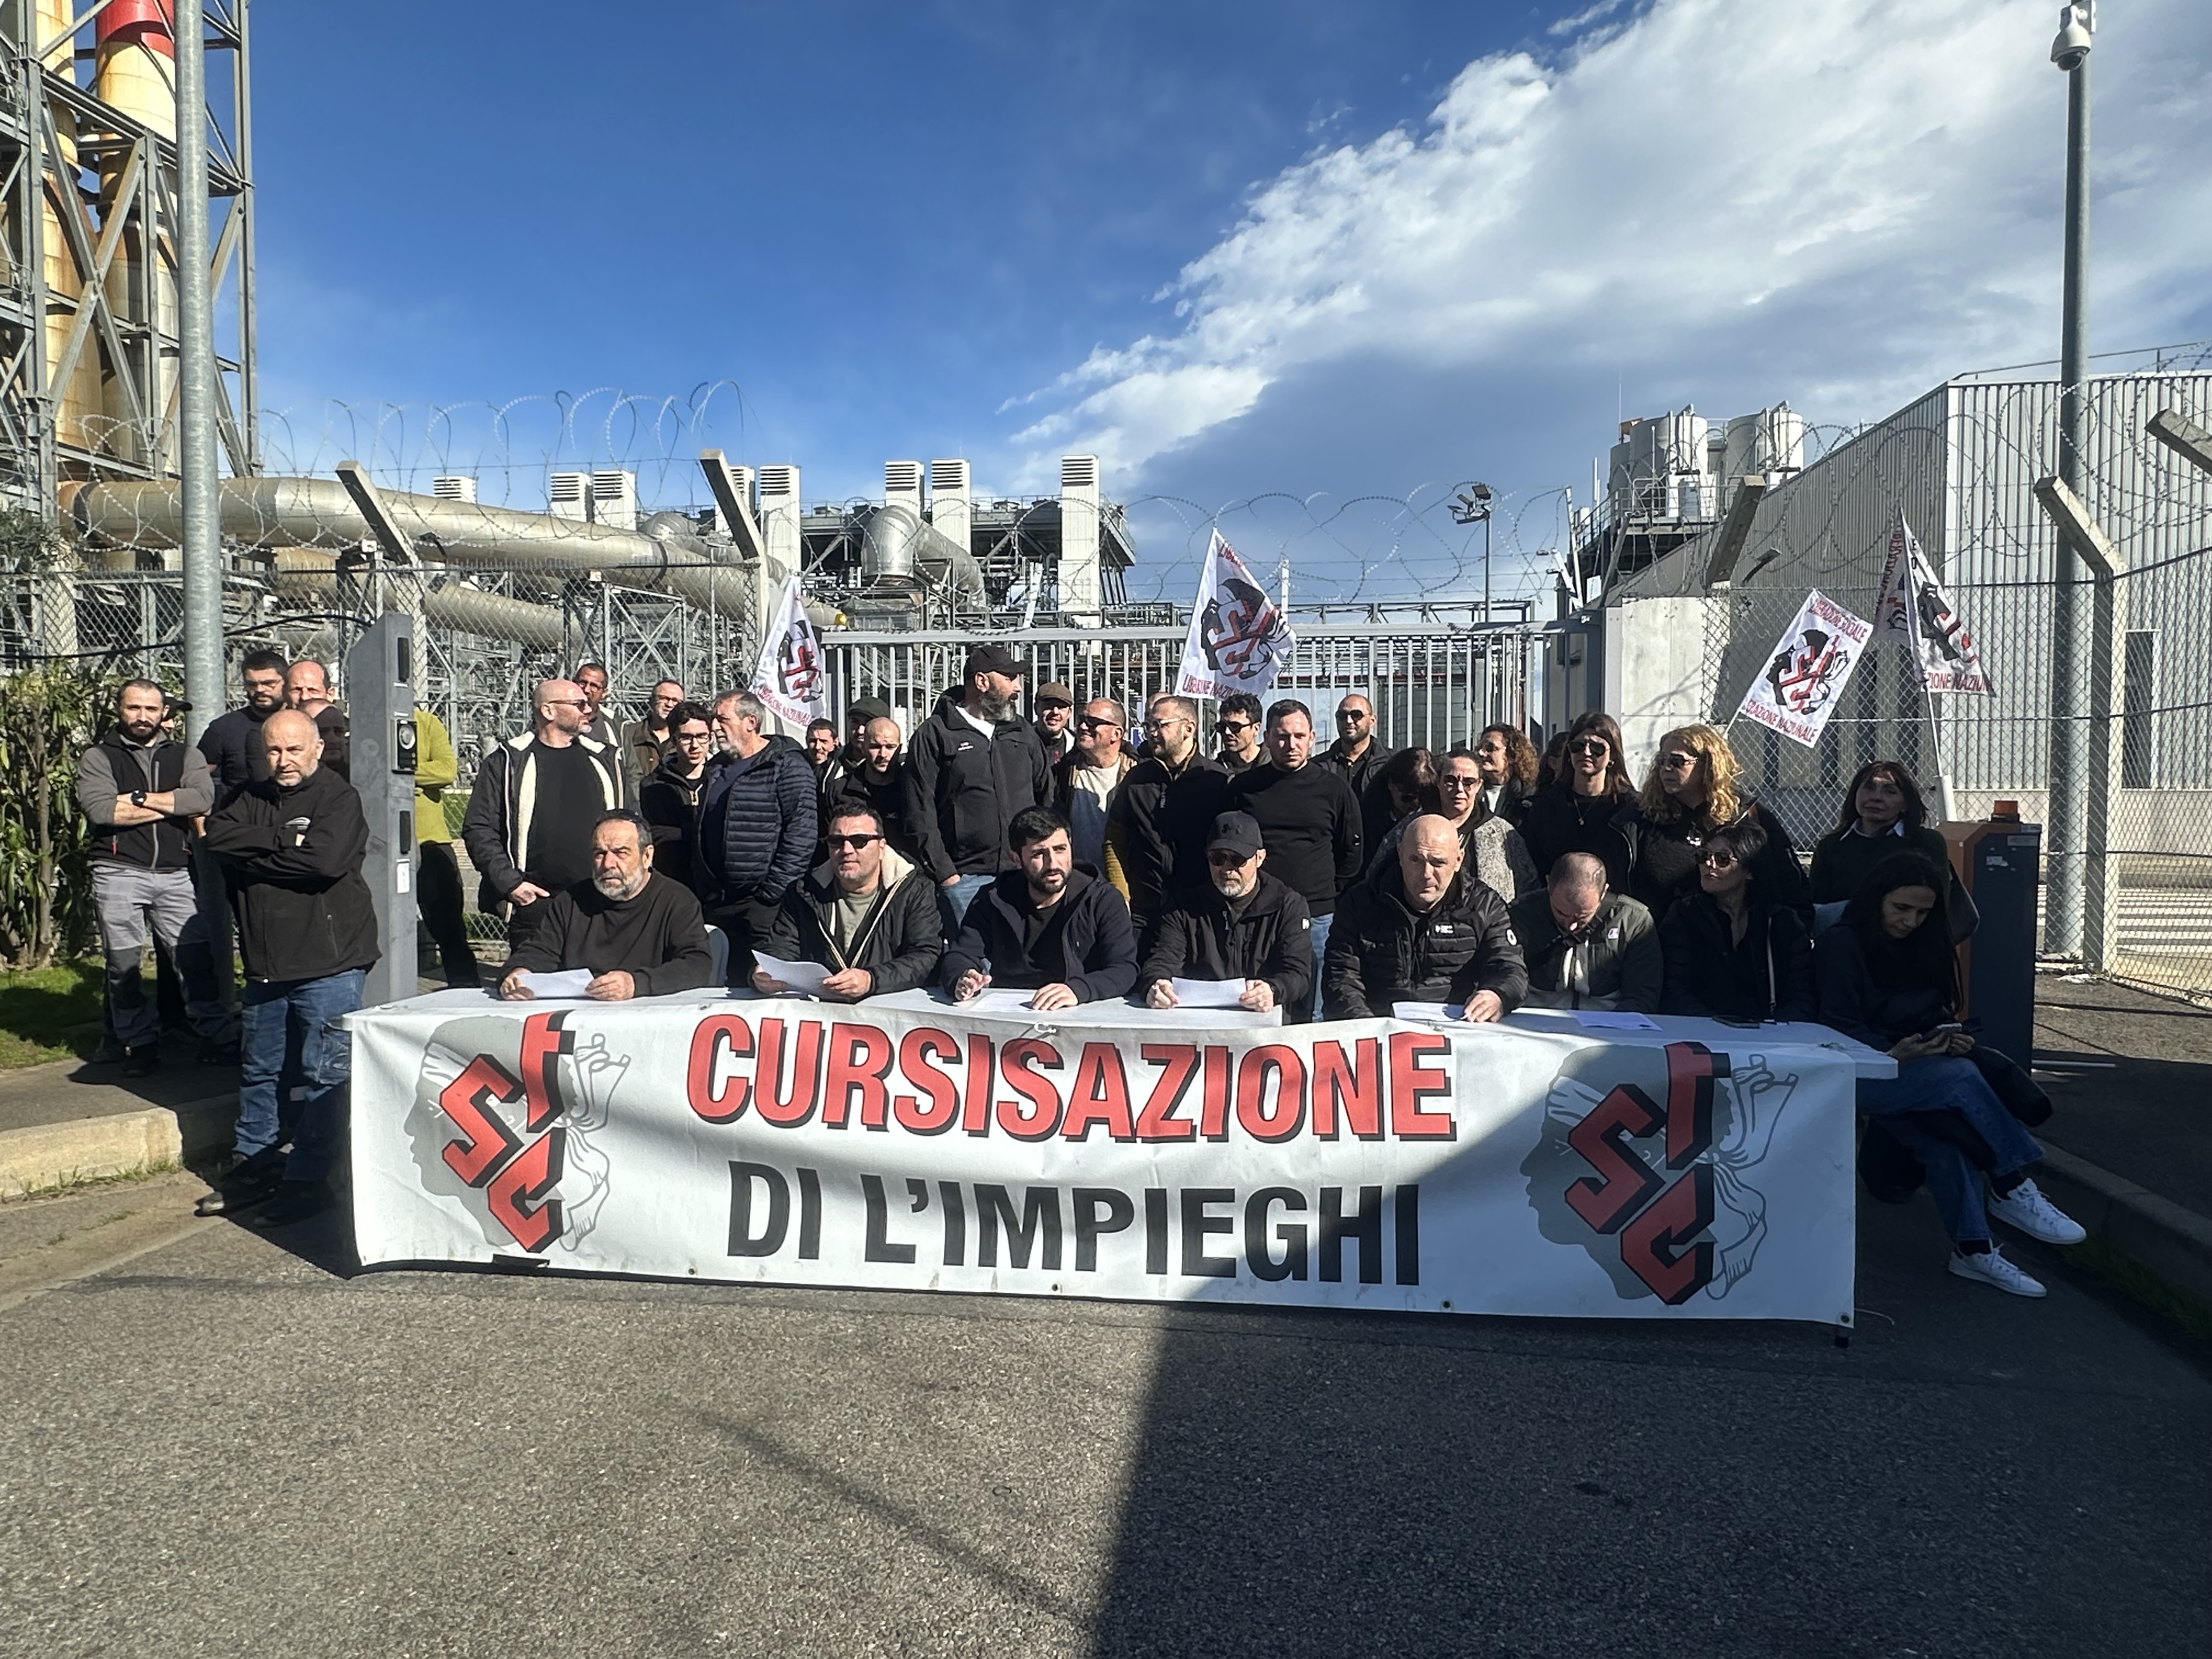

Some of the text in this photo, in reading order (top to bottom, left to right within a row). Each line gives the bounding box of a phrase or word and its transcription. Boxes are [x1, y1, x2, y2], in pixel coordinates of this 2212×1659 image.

[687, 1014, 1457, 1144] CURSISAZIONE
[727, 1160, 1420, 1285] DI L'IMPIEGHI
